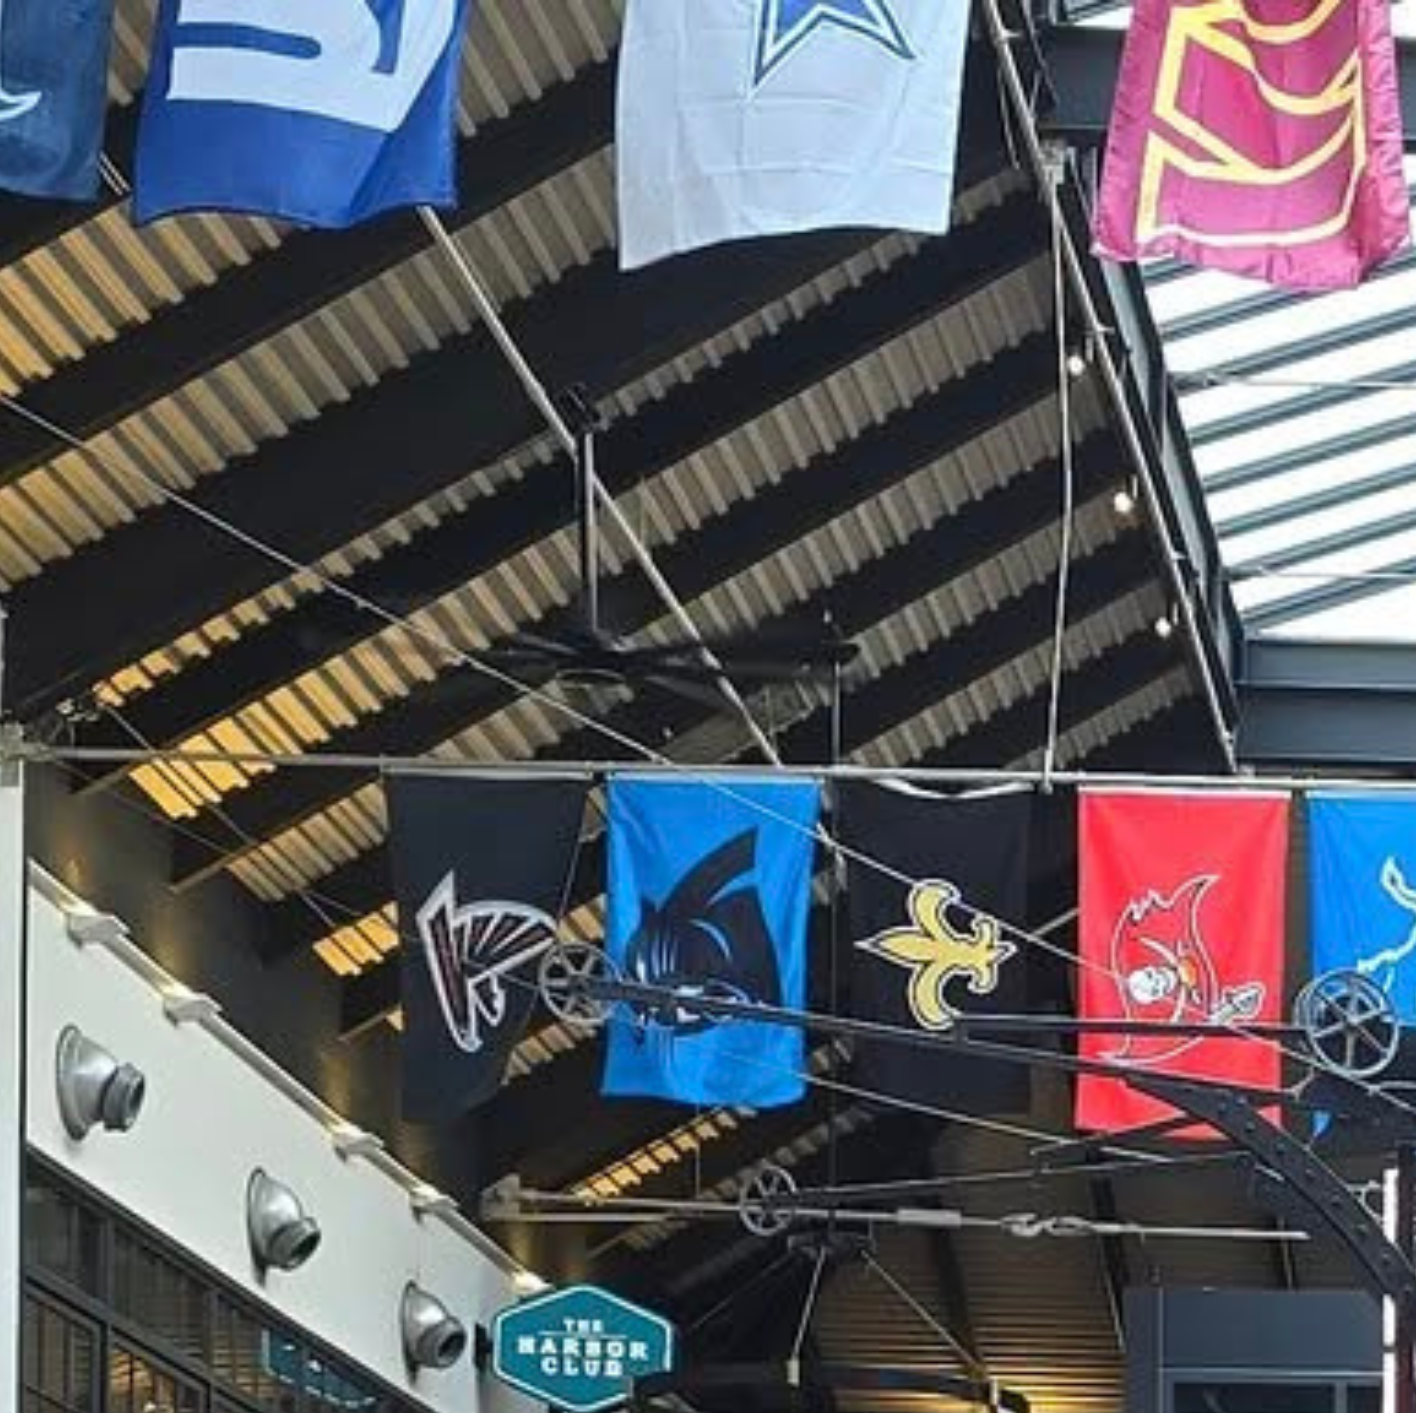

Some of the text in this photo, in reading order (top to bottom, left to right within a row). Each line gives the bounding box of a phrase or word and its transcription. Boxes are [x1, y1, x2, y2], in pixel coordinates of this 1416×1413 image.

[562, 1317, 604, 1334] THE
[517, 1336, 650, 1361] HARBOR
[541, 1356, 624, 1377] CLUB
